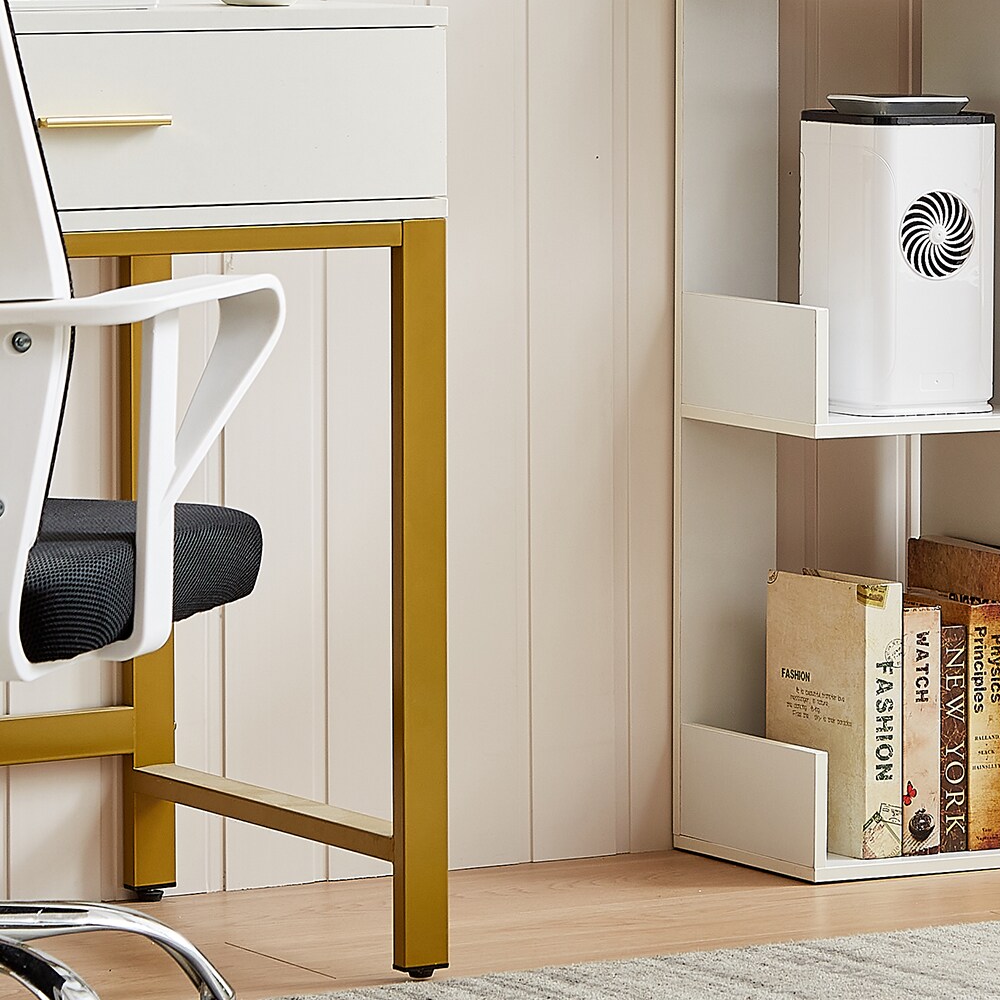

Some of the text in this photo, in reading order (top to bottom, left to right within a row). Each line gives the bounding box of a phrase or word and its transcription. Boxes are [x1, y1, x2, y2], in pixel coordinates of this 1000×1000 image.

[781, 667, 811, 682] FASHION
[915, 631, 929, 702] WATCH
[971, 626, 987, 713] Principles
[876, 661, 893, 780] FASHION
[945, 646, 965, 834] NEW YORK
